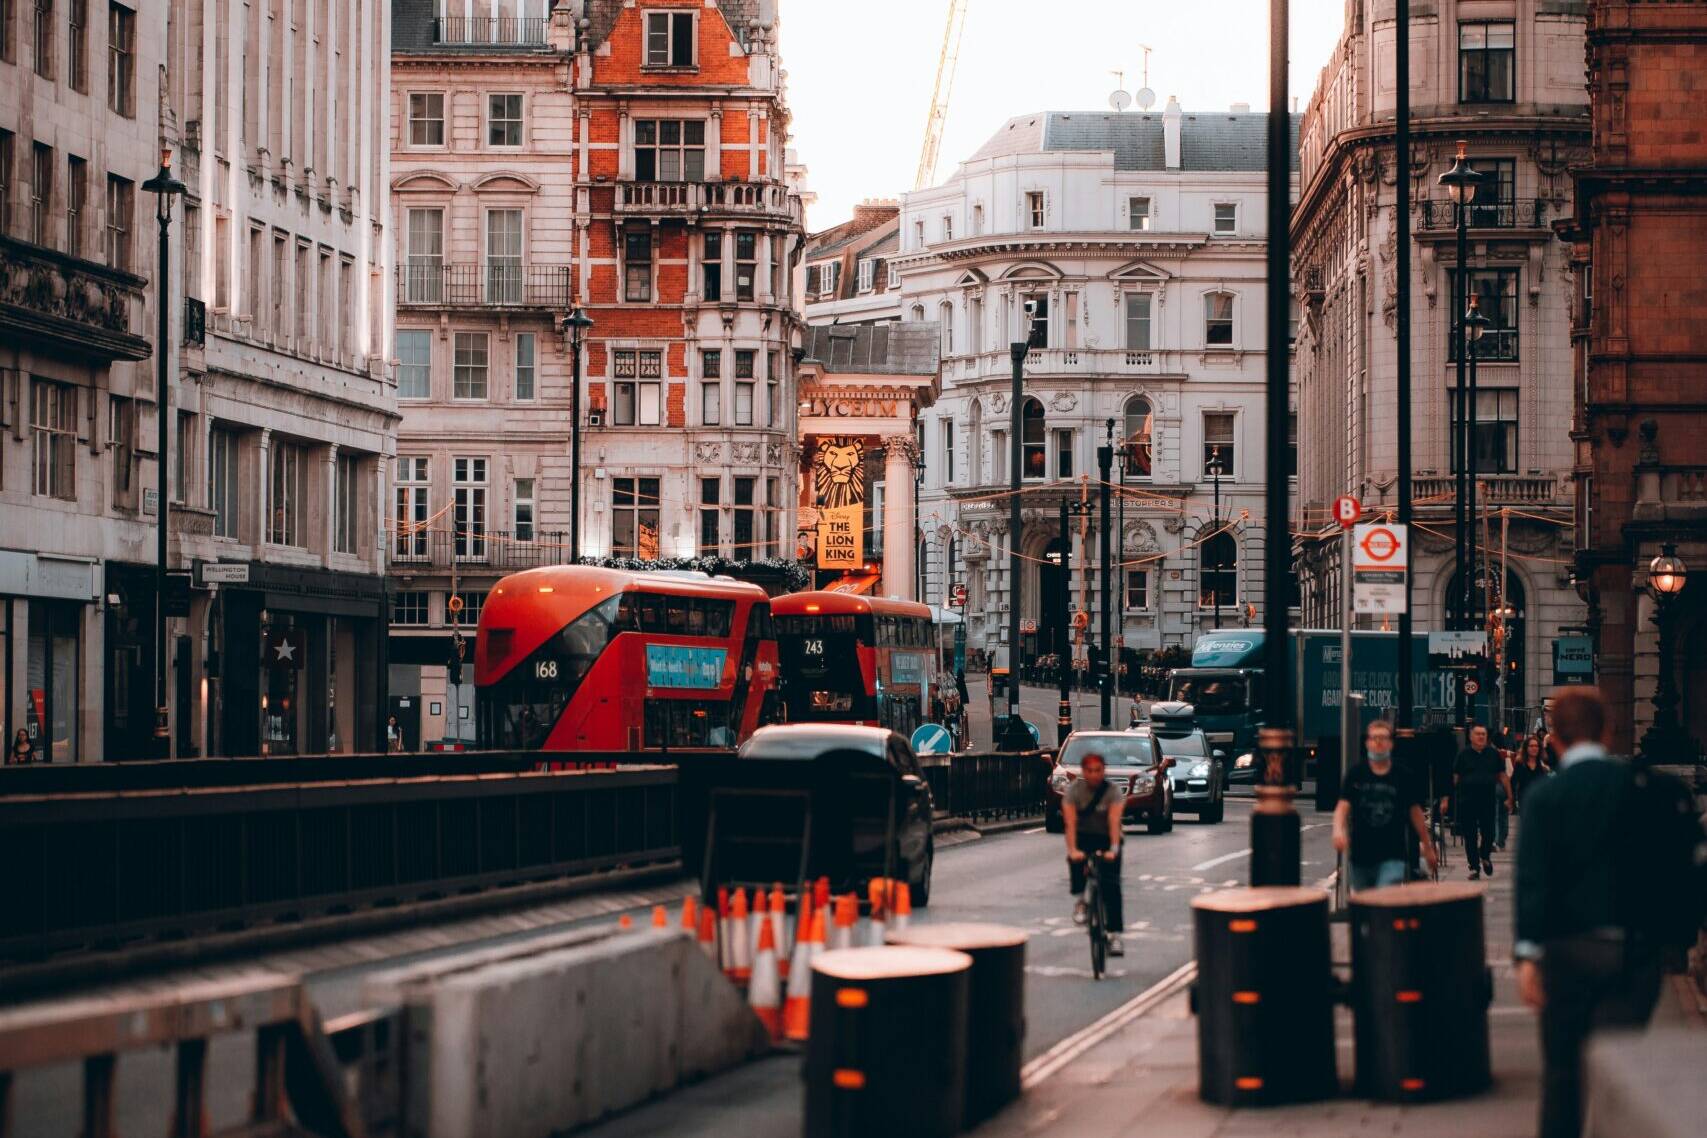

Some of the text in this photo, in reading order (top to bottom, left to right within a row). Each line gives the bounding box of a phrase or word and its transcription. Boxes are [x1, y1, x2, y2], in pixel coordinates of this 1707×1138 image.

[809, 399, 897, 418] LYCEUM
[1340, 499, 1356, 520] B
[829, 522, 850, 531] THE
[826, 536, 854, 545] LION
[825, 549, 855, 559] KING
[805, 640, 823, 655] 243
[535, 661, 557, 678] 168
[1466, 683, 1477, 691] 20
[1369, 690, 1392, 707] CLOCK
